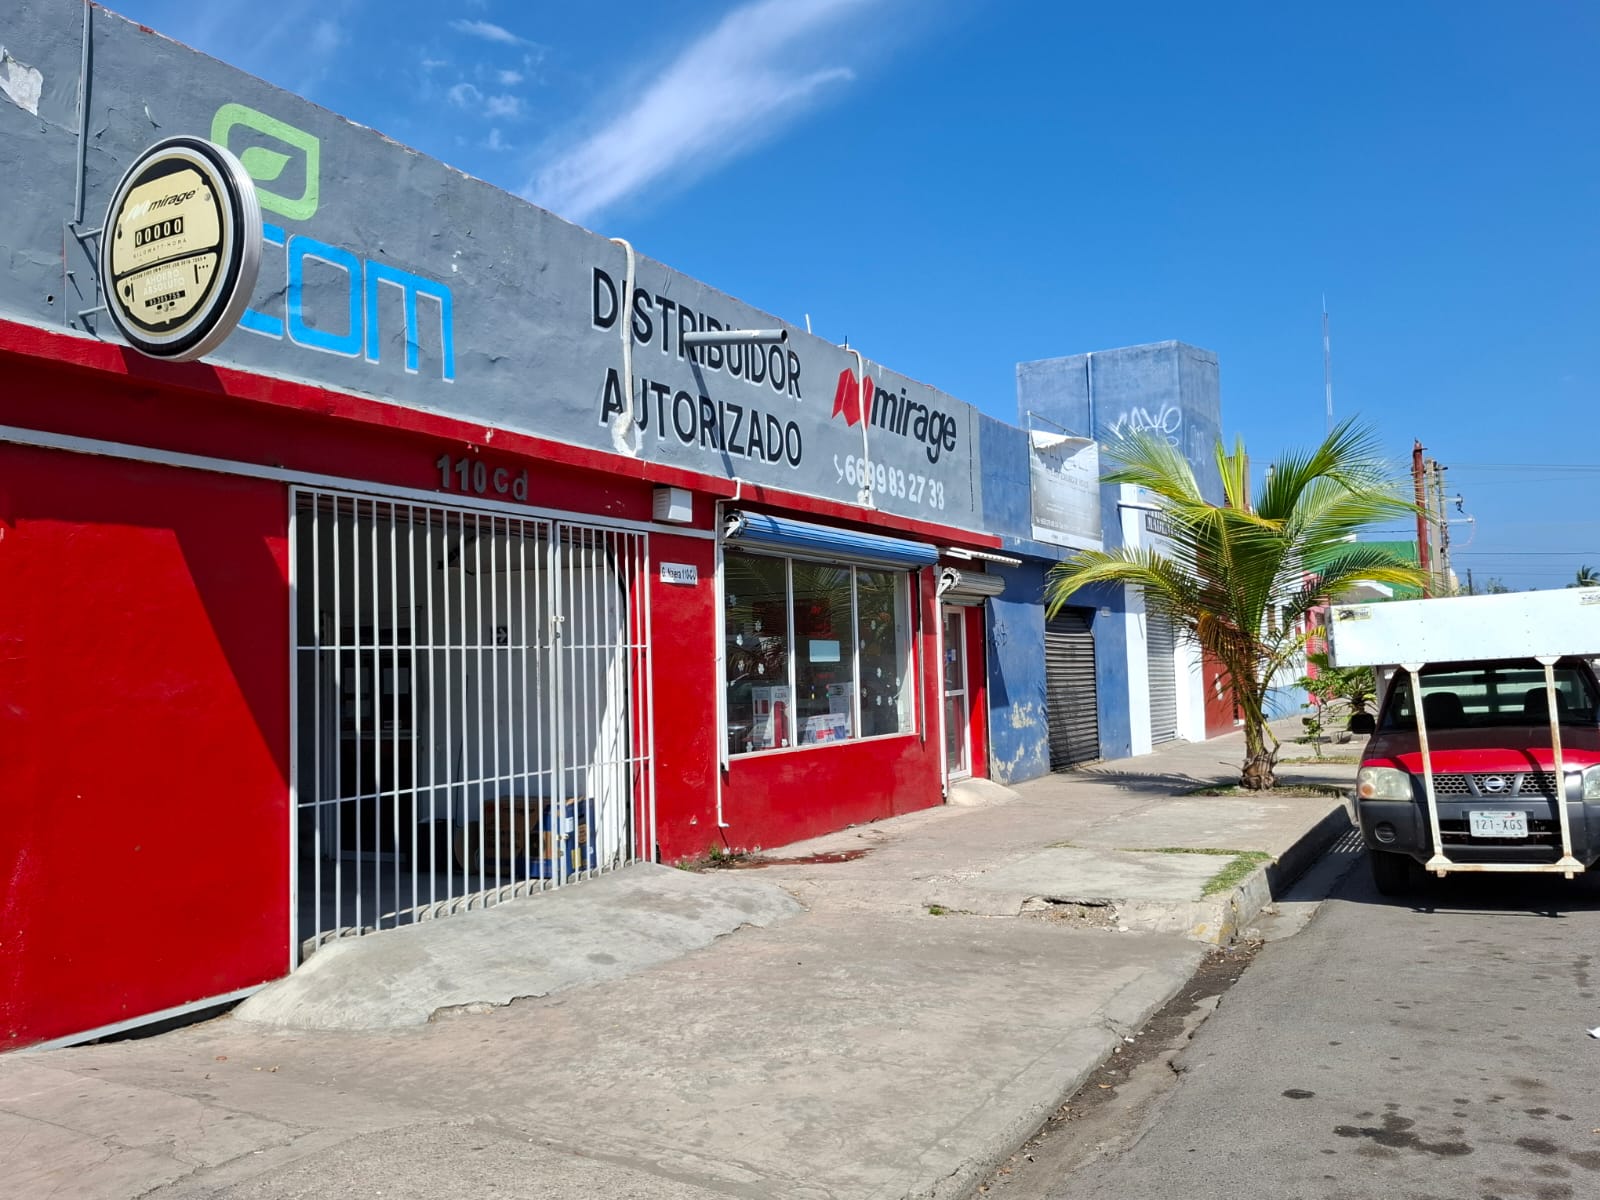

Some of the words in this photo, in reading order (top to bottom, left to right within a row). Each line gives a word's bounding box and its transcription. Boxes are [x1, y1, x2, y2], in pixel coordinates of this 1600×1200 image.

[148, 189, 196, 212] mirage
[136, 218, 182, 247] 00000
[599, 367, 802, 467] AUTORIZADO
[870, 386, 957, 464] mirage
